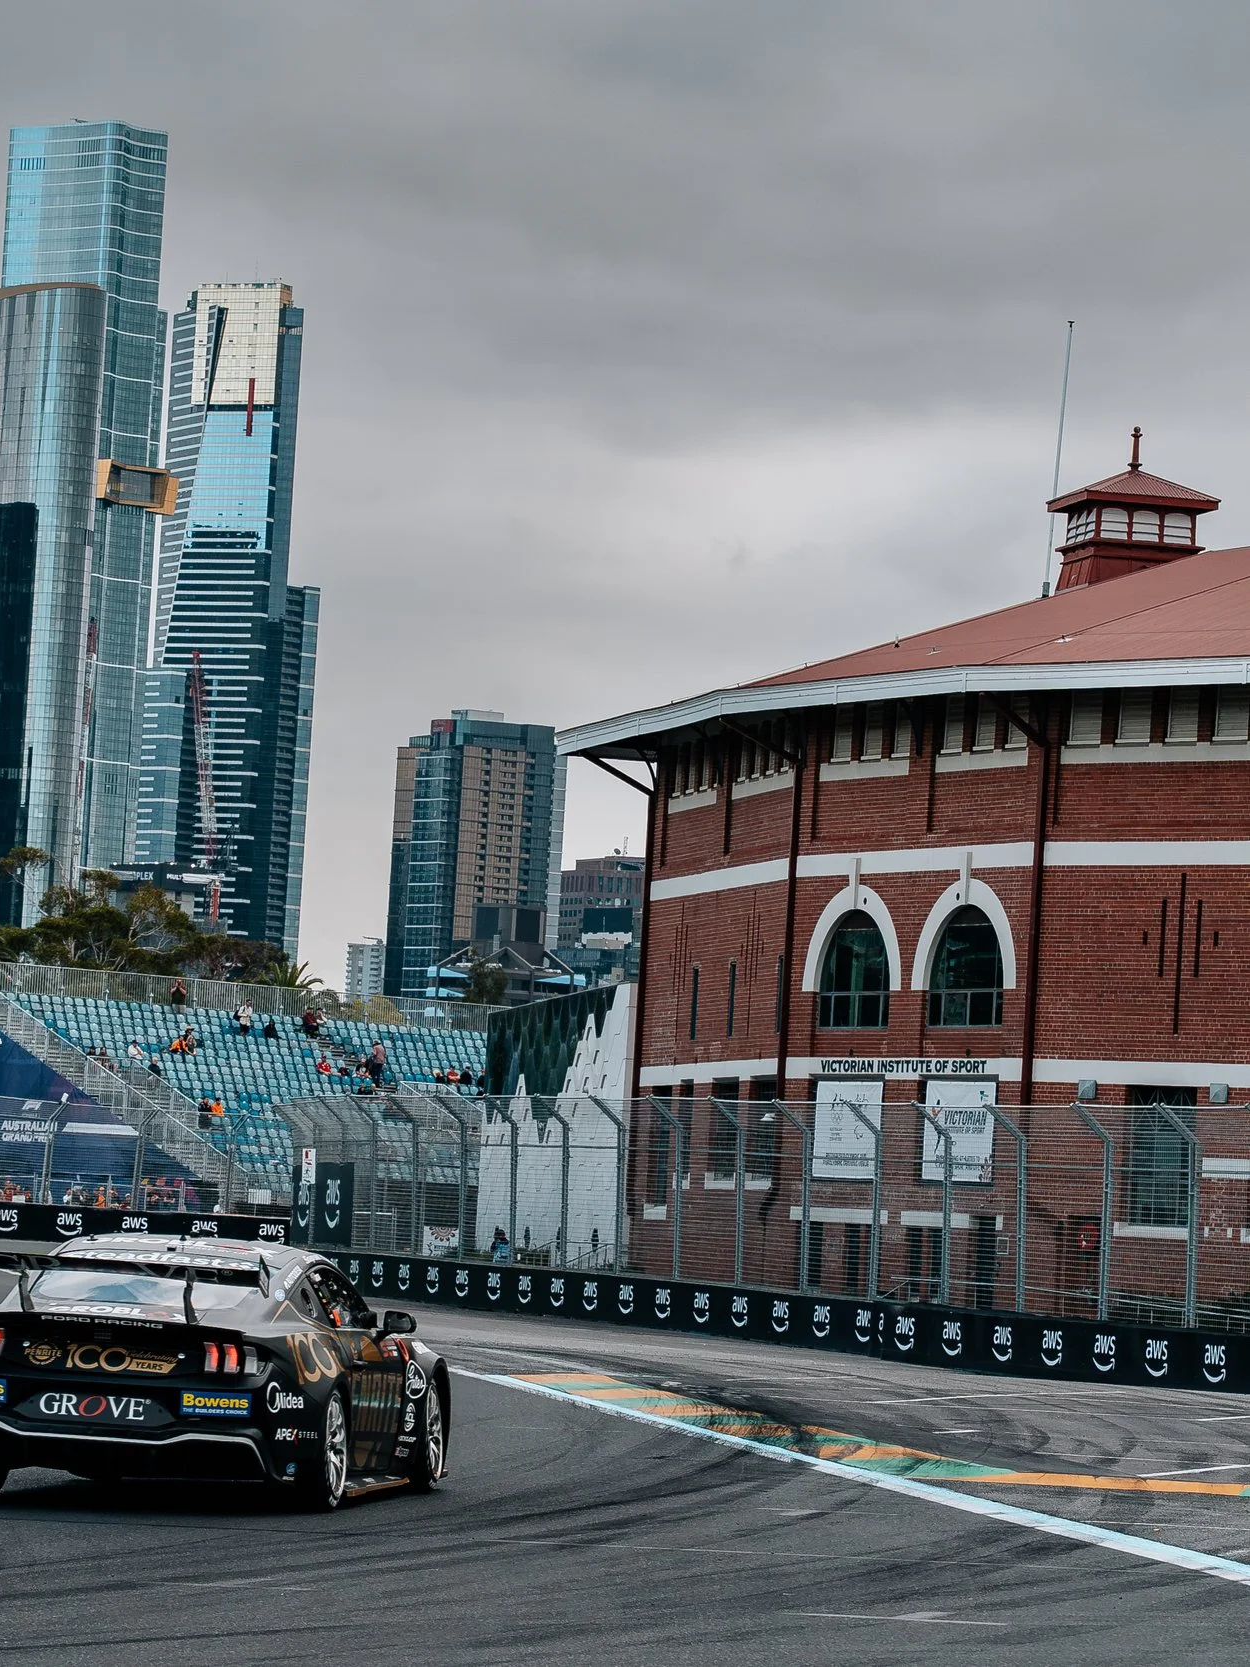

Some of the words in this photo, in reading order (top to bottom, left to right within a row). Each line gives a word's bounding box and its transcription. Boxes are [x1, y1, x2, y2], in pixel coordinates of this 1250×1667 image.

[821, 1060, 874, 1073] VICTORIAN
[877, 1060, 932, 1073] INSTITUTE
[935, 1060, 949, 1073] OF
[951, 1060, 988, 1074] SPORT
[944, 1110, 988, 1126] VICTORIAN
[1, 1132, 32, 1142] GRAND
[326, 1179, 341, 1205] aws
[57, 1213, 82, 1226] aws
[122, 1216, 148, 1230] aws
[192, 1220, 218, 1233] aws
[259, 1223, 285, 1237] aws
[456, 1270, 468, 1284] aws
[488, 1273, 500, 1287] aws
[519, 1276, 531, 1290] aws
[551, 1278, 564, 1293] aws
[584, 1281, 597, 1296] aws
[619, 1285, 633, 1300] aws
[656, 1289, 670, 1304] aws
[694, 1292, 709, 1308] aws
[732, 1296, 747, 1313] aws
[773, 1301, 789, 1318] aws
[814, 1305, 830, 1323] aws
[41, 1315, 91, 1323] FORD
[94, 1318, 163, 1329] RACING
[895, 1316, 915, 1335] aws
[943, 1321, 961, 1340] aws
[994, 1326, 1012, 1345] aws
[1043, 1330, 1062, 1350] aws
[1094, 1334, 1115, 1355] aws
[24, 1348, 62, 1357] PENRITE
[1146, 1339, 1168, 1360] aws
[1204, 1344, 1225, 1365] aws
[65, 1343, 131, 1372] 100
[135, 1361, 163, 1370] YEARS
[182, 1393, 249, 1409] Bowens
[266, 1381, 304, 1413] Midea
[274, 1427, 298, 1442] APEX
[298, 1431, 318, 1439] STEEL
